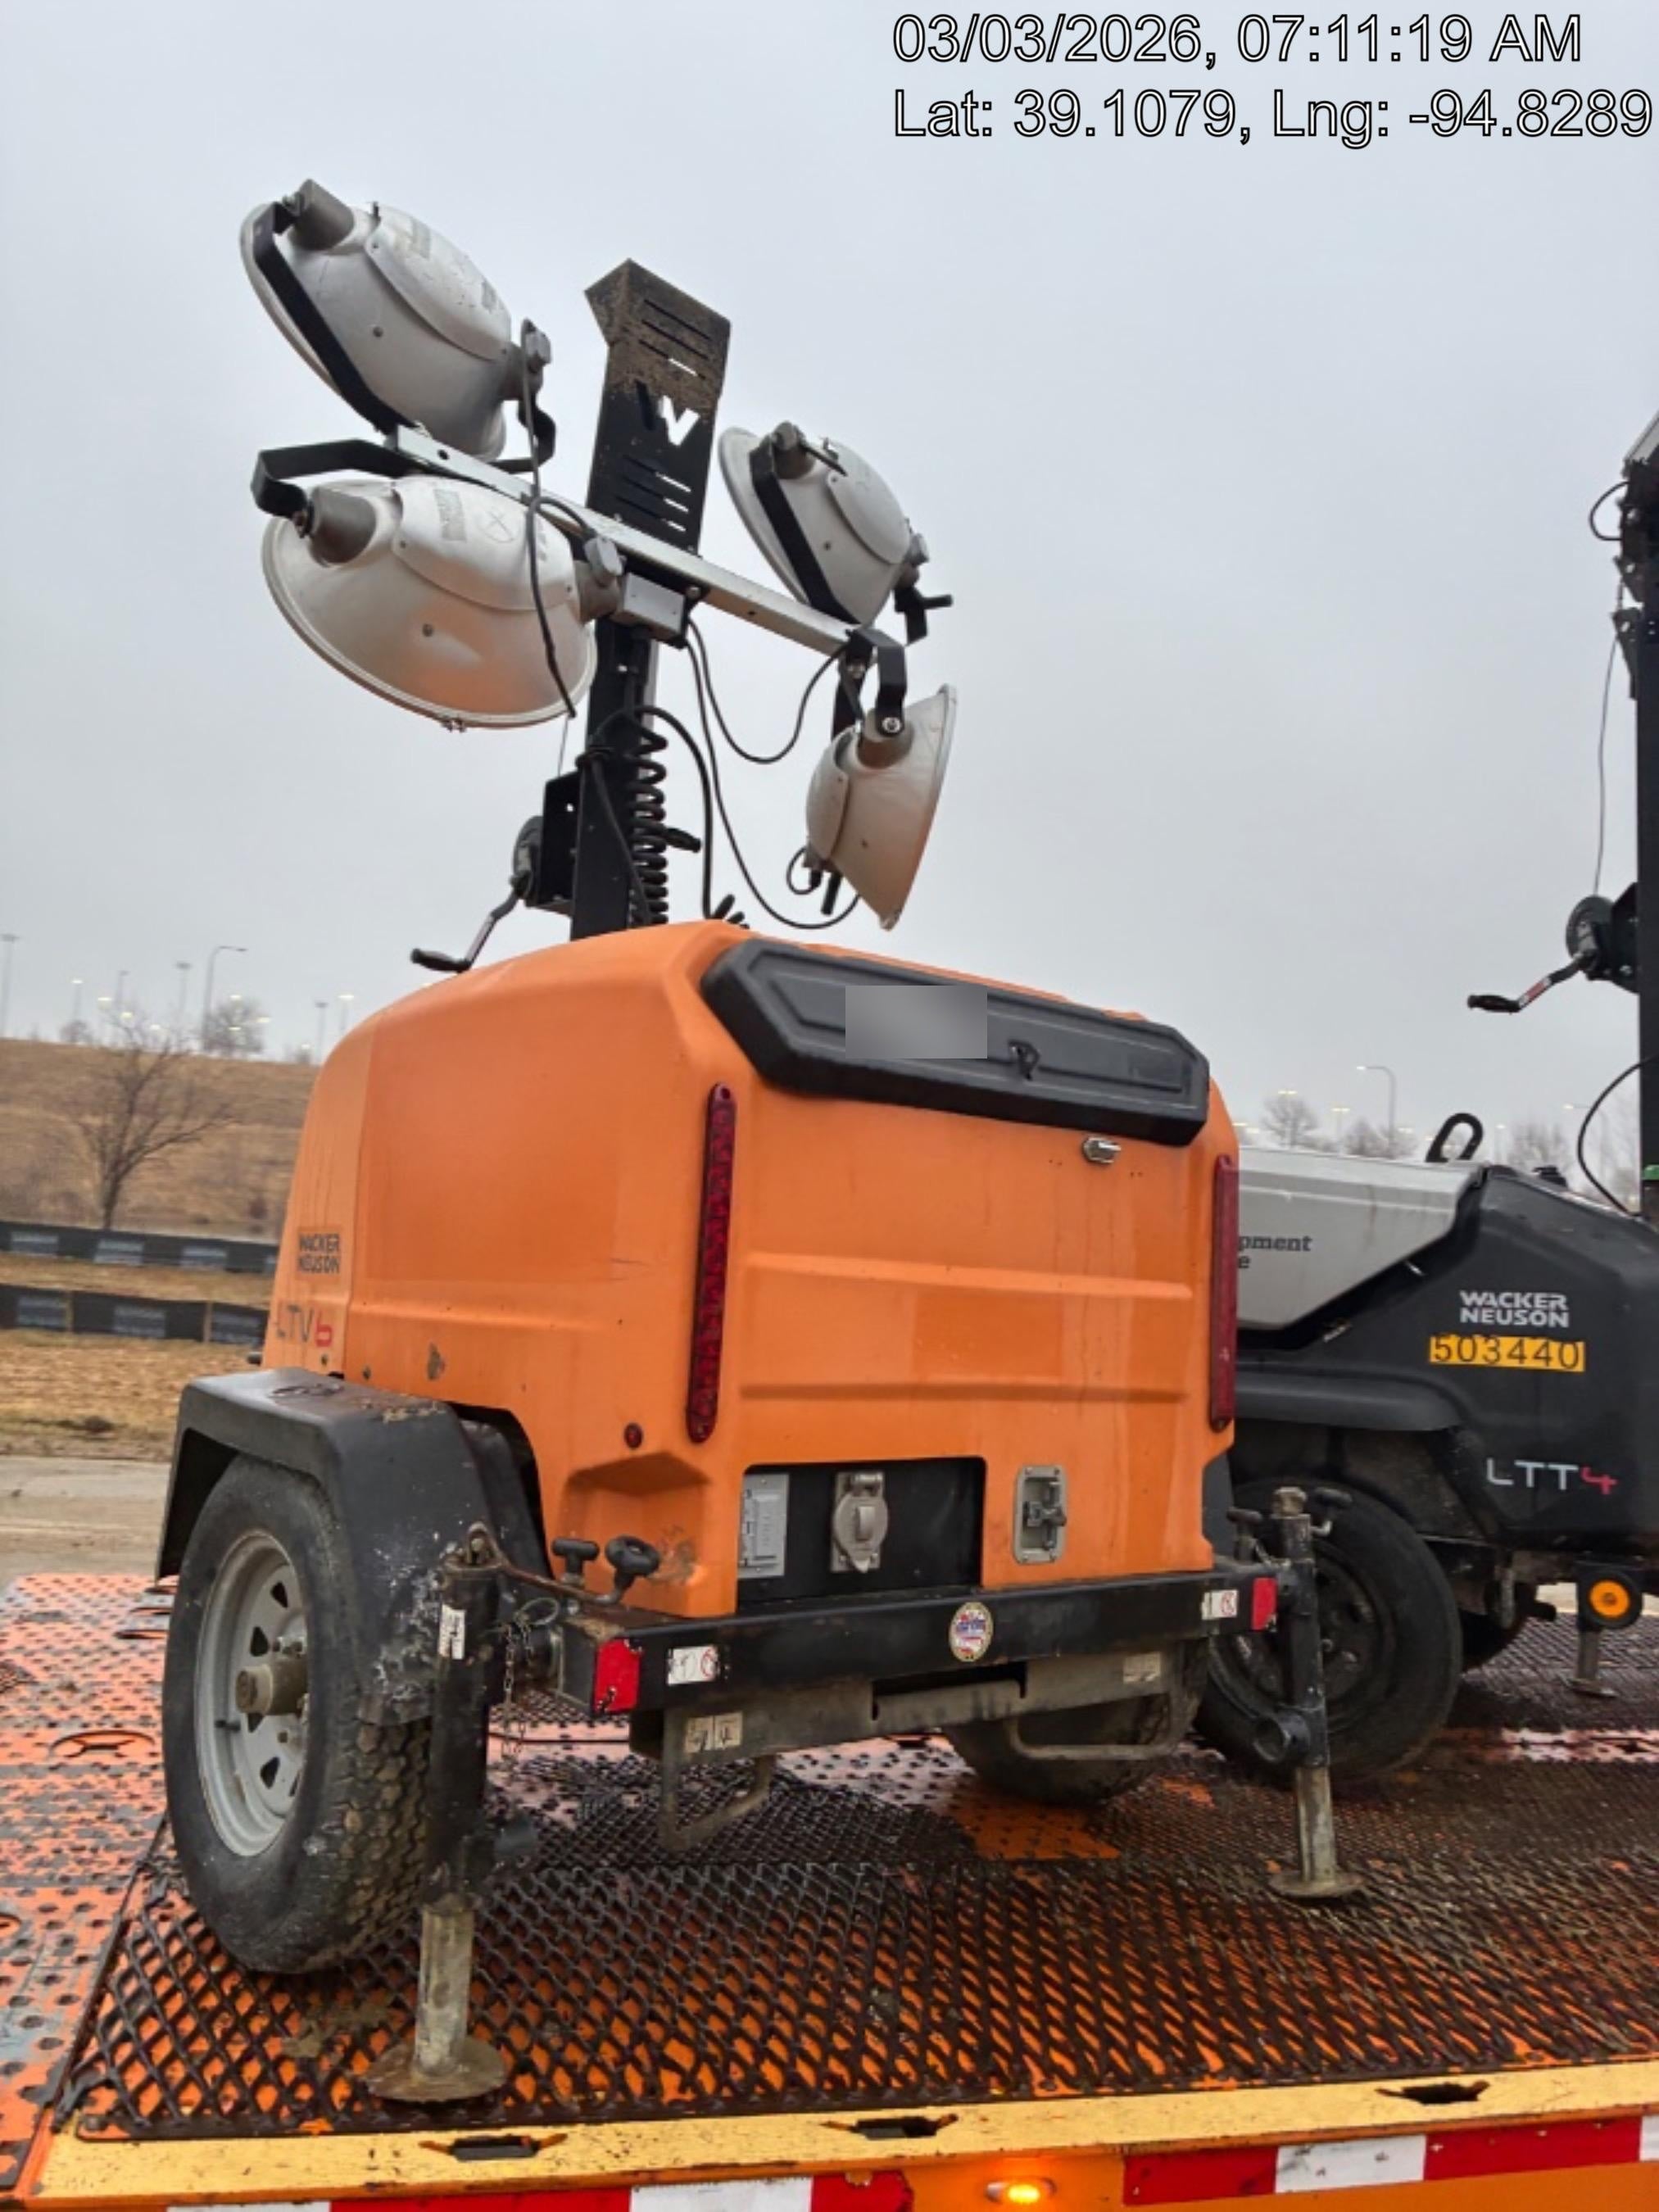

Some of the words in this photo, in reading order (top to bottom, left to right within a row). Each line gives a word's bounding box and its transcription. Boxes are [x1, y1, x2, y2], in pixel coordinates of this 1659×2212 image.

[1459, 1290, 1570, 1311] WACKER
[1459, 1307, 1570, 1328] NEUSON
[1432, 1335, 1580, 1370] 503440
[1485, 1457, 1619, 1496] LTT4
